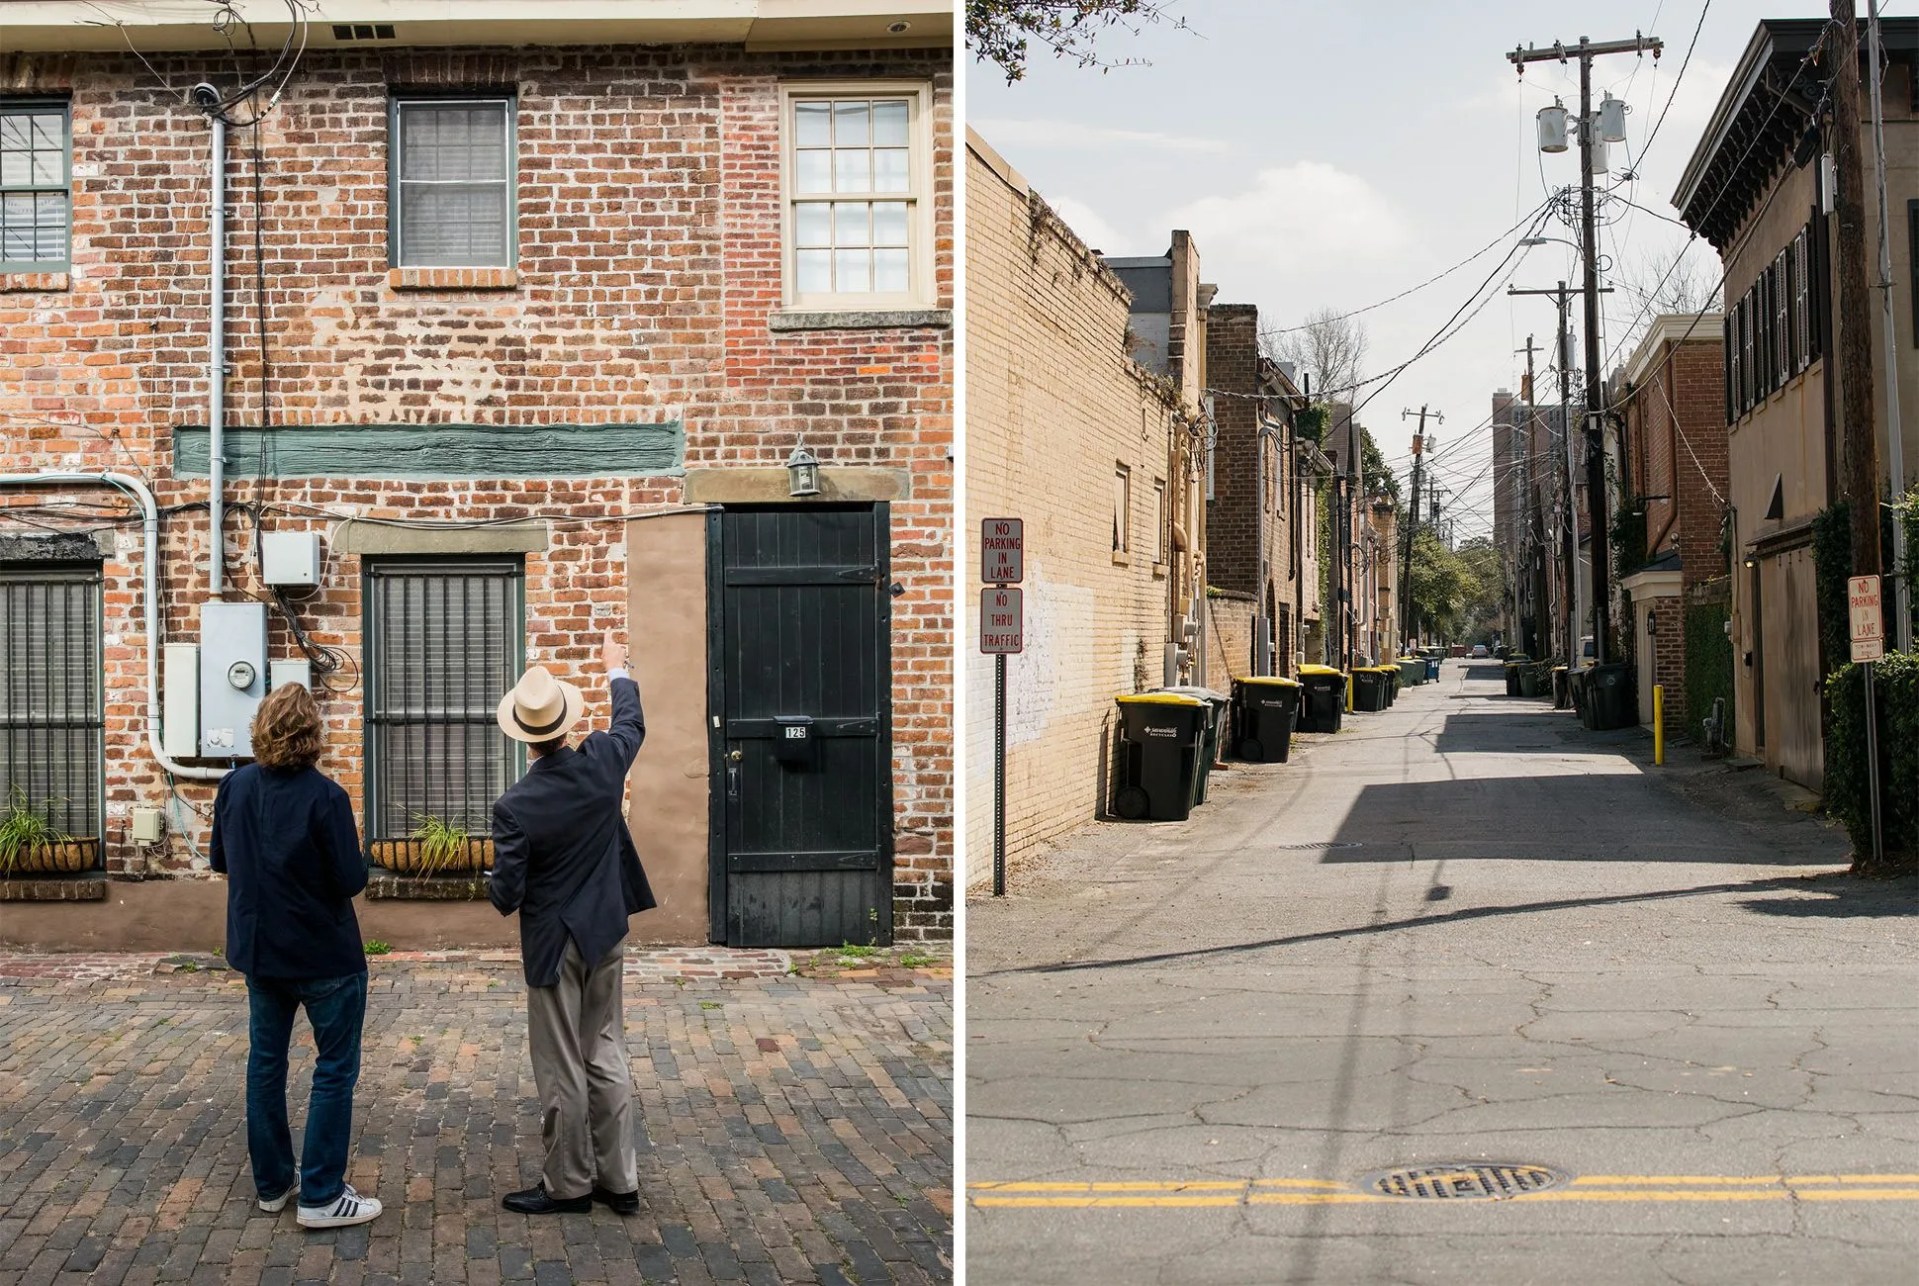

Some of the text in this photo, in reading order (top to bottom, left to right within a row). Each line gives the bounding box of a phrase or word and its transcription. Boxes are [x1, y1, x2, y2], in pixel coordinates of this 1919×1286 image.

[995, 523, 1010, 536] NO
[984, 538, 1021, 550] PARKING
[998, 552, 1007, 564] IN
[990, 566, 1014, 579] LANE
[1857, 582, 1869, 593] NO
[995, 594, 1008, 607] NO
[1851, 595, 1879, 608] PARKING
[990, 614, 1013, 626] THRU
[1856, 622, 1876, 636] LANE
[984, 634, 1019, 647] TRAFFIC
[787, 728, 805, 738] 125
